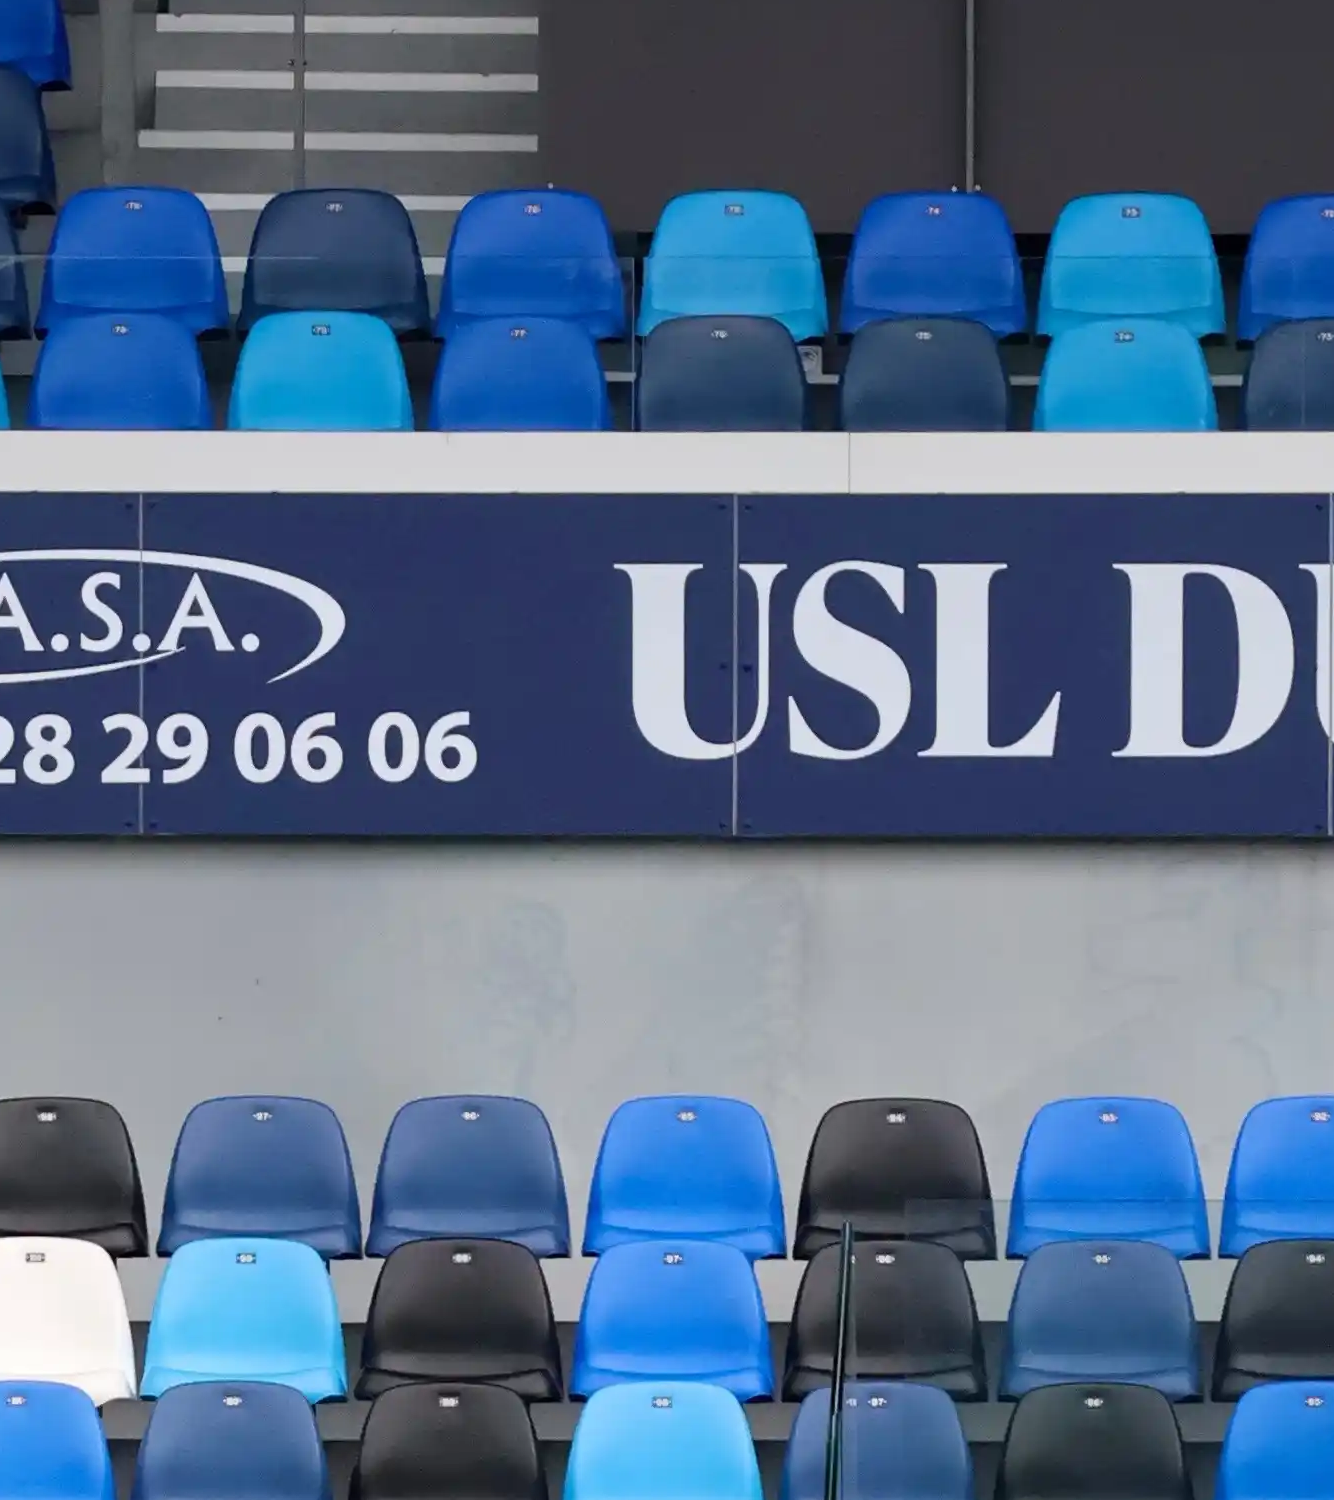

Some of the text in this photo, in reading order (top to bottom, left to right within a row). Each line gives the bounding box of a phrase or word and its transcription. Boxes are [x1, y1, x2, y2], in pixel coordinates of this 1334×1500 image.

[613, 560, 1061, 759] USL
[100, 711, 209, 784] 29
[233, 710, 344, 783] 06
[367, 710, 478, 783] 06
